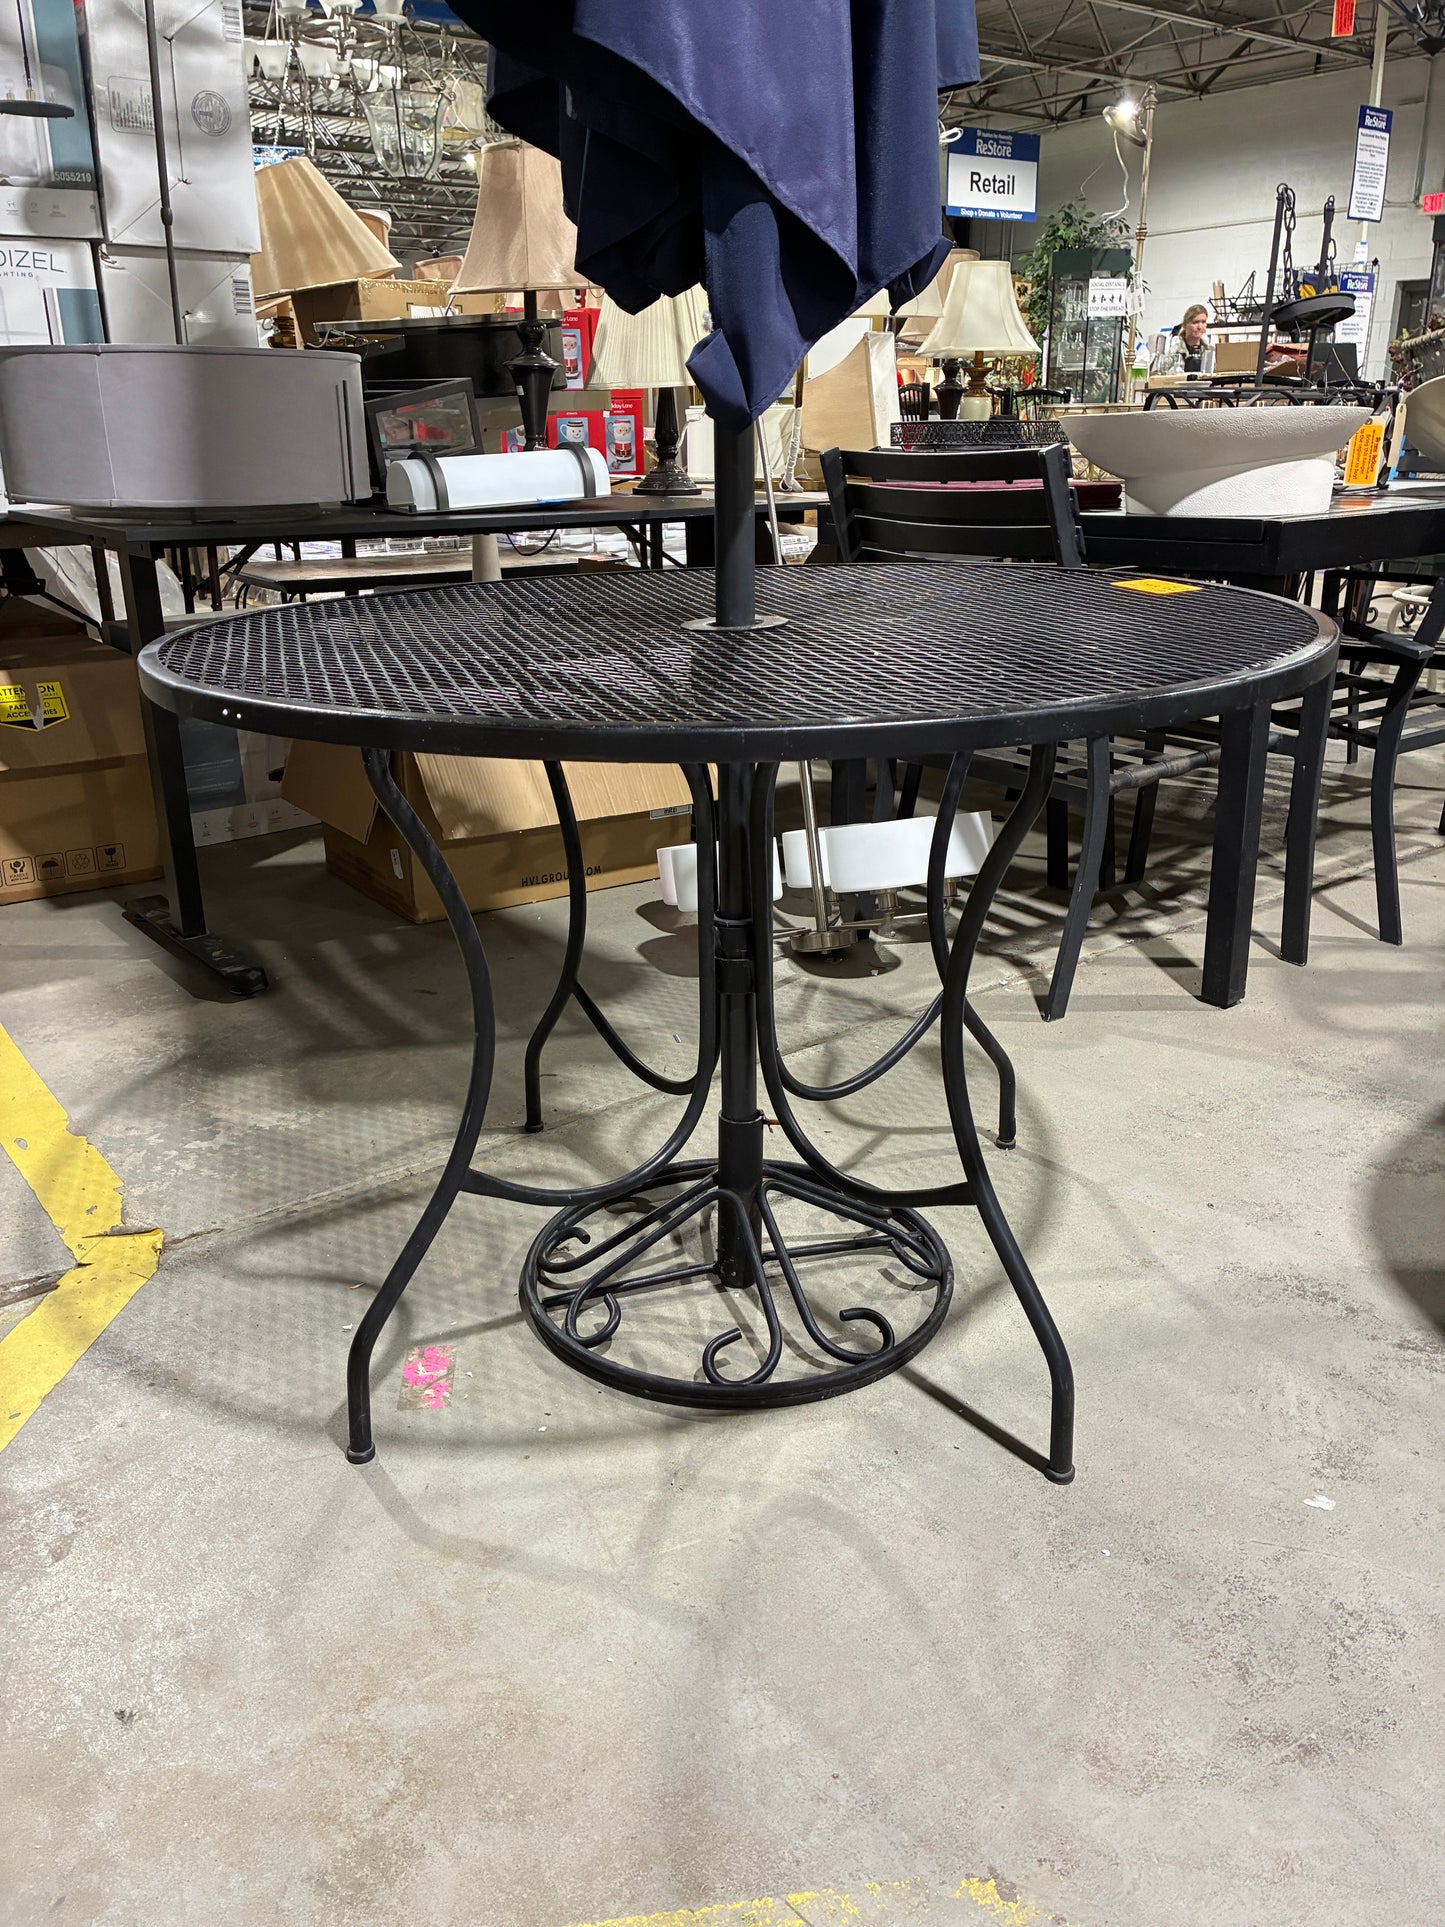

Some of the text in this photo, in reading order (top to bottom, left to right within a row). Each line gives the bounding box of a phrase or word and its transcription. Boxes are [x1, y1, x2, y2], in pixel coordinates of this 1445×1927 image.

[1365, 115, 1387, 130] ReStore
[976, 138, 1012, 157] ReStore
[54, 171, 92, 183] 5055219
[970, 171, 1015, 195] Retail
[1423, 192, 1445, 213] EXIT
[960, 207, 1023, 220] Shop Donate Volunteer
[1346, 278, 1368, 290] ReStore
